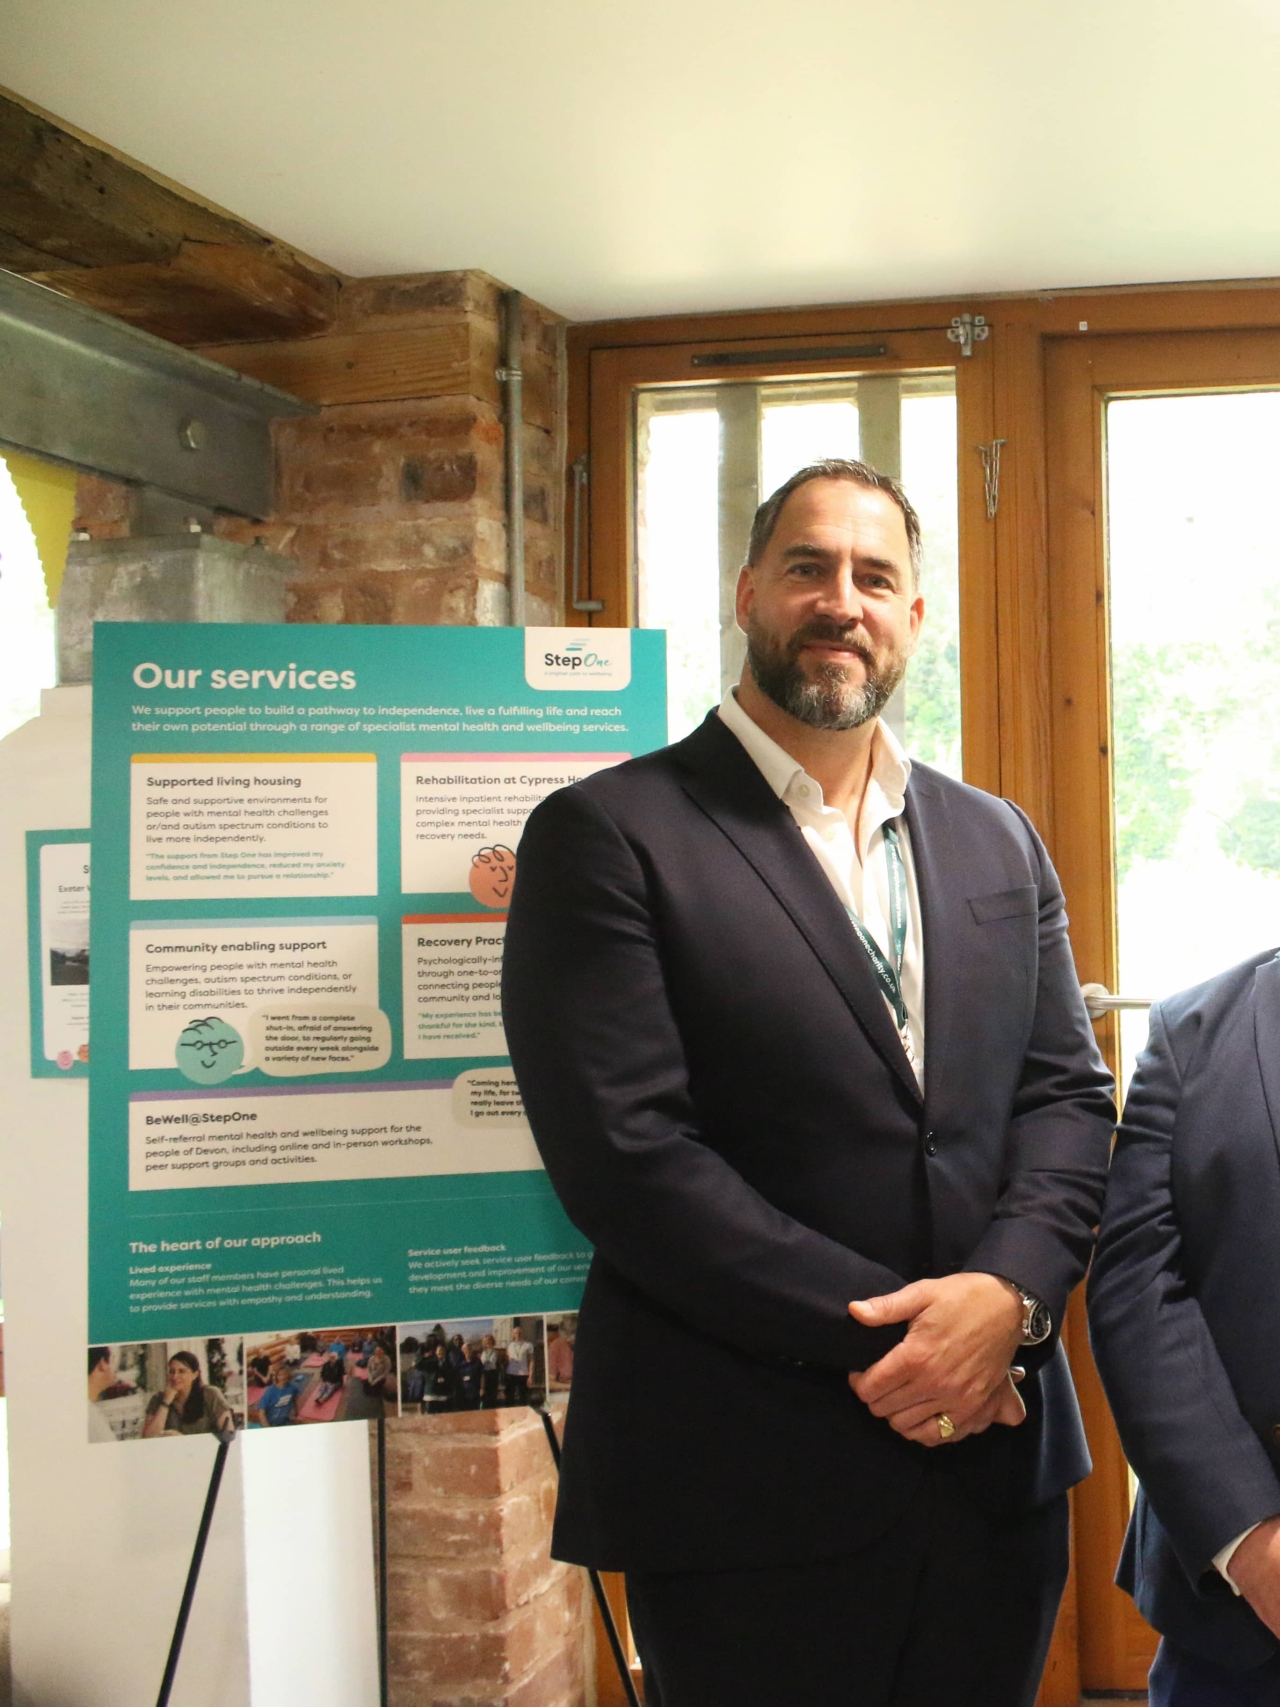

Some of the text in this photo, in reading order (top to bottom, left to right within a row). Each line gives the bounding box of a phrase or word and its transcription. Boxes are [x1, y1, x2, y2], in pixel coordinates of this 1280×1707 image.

[544, 653, 610, 670] Step One
[133, 662, 356, 690] Our services
[132, 705, 622, 718] We support people to build a pathway to independence, live a fulfilling life and reach
[131, 720, 629, 734] their own potential through a range of specialist mental health and wellbeing services.
[146, 776, 301, 789] Supported living housing
[416, 775, 501, 784] Rehabilitation
[504, 776, 516, 784] at
[521, 775, 564, 787] Cypress
[146, 795, 328, 806] Safe and supportive environments for
[146, 810, 180, 819] people
[207, 809, 240, 817] mental
[244, 809, 275, 817] health
[278, 809, 329, 819] challenges
[58, 885, 85, 894] Exeter
[145, 941, 327, 955] Community enabling support
[417, 936, 504, 948] Recovery Prac
[145, 1111, 258, 1126] BeWell@StepOne
[130, 1232, 321, 1253] The heart of our approach
